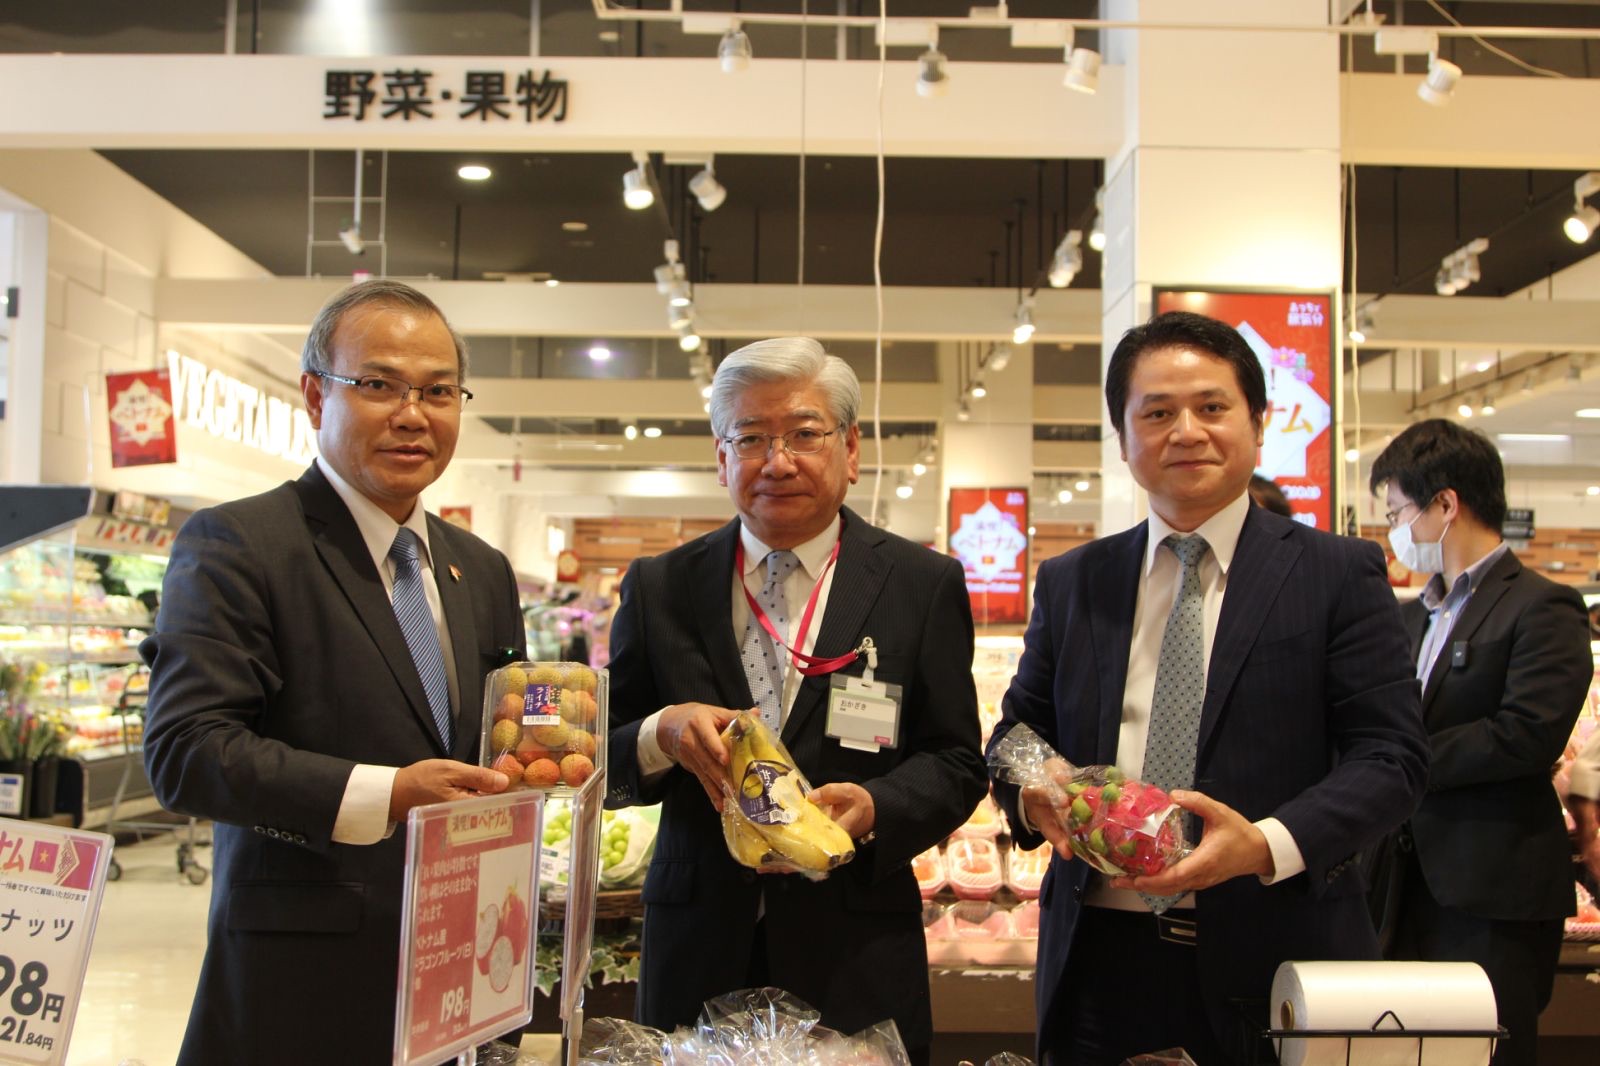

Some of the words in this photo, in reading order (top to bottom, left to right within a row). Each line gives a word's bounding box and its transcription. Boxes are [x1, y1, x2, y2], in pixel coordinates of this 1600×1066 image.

[323, 69, 568, 122] 野菜・果物
[534, 686, 544, 709] ライチ
[1, 909, 74, 941] ナッツ
